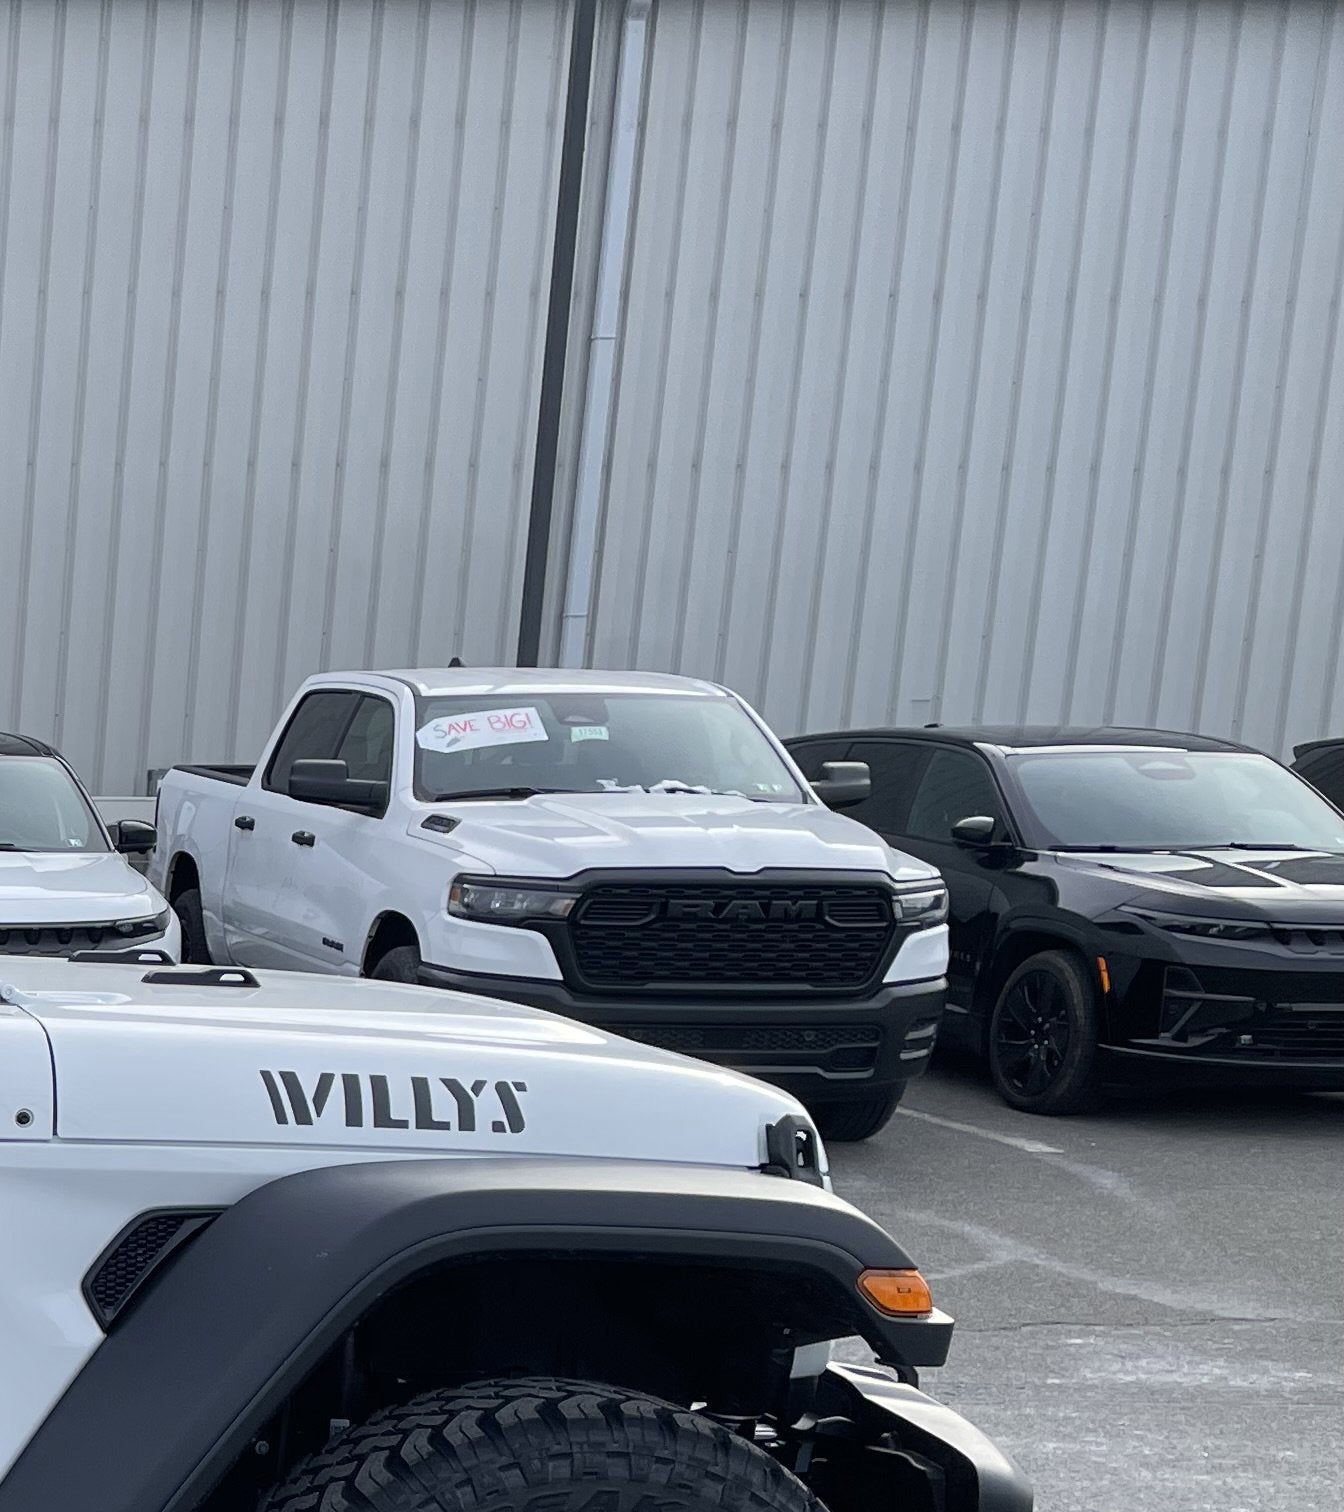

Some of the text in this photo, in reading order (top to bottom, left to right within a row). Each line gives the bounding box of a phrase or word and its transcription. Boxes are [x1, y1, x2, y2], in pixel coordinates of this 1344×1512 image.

[432, 718, 481, 739] SAVE
[666, 899, 819, 921] RAM
[259, 1069, 528, 1134] WILLYS
